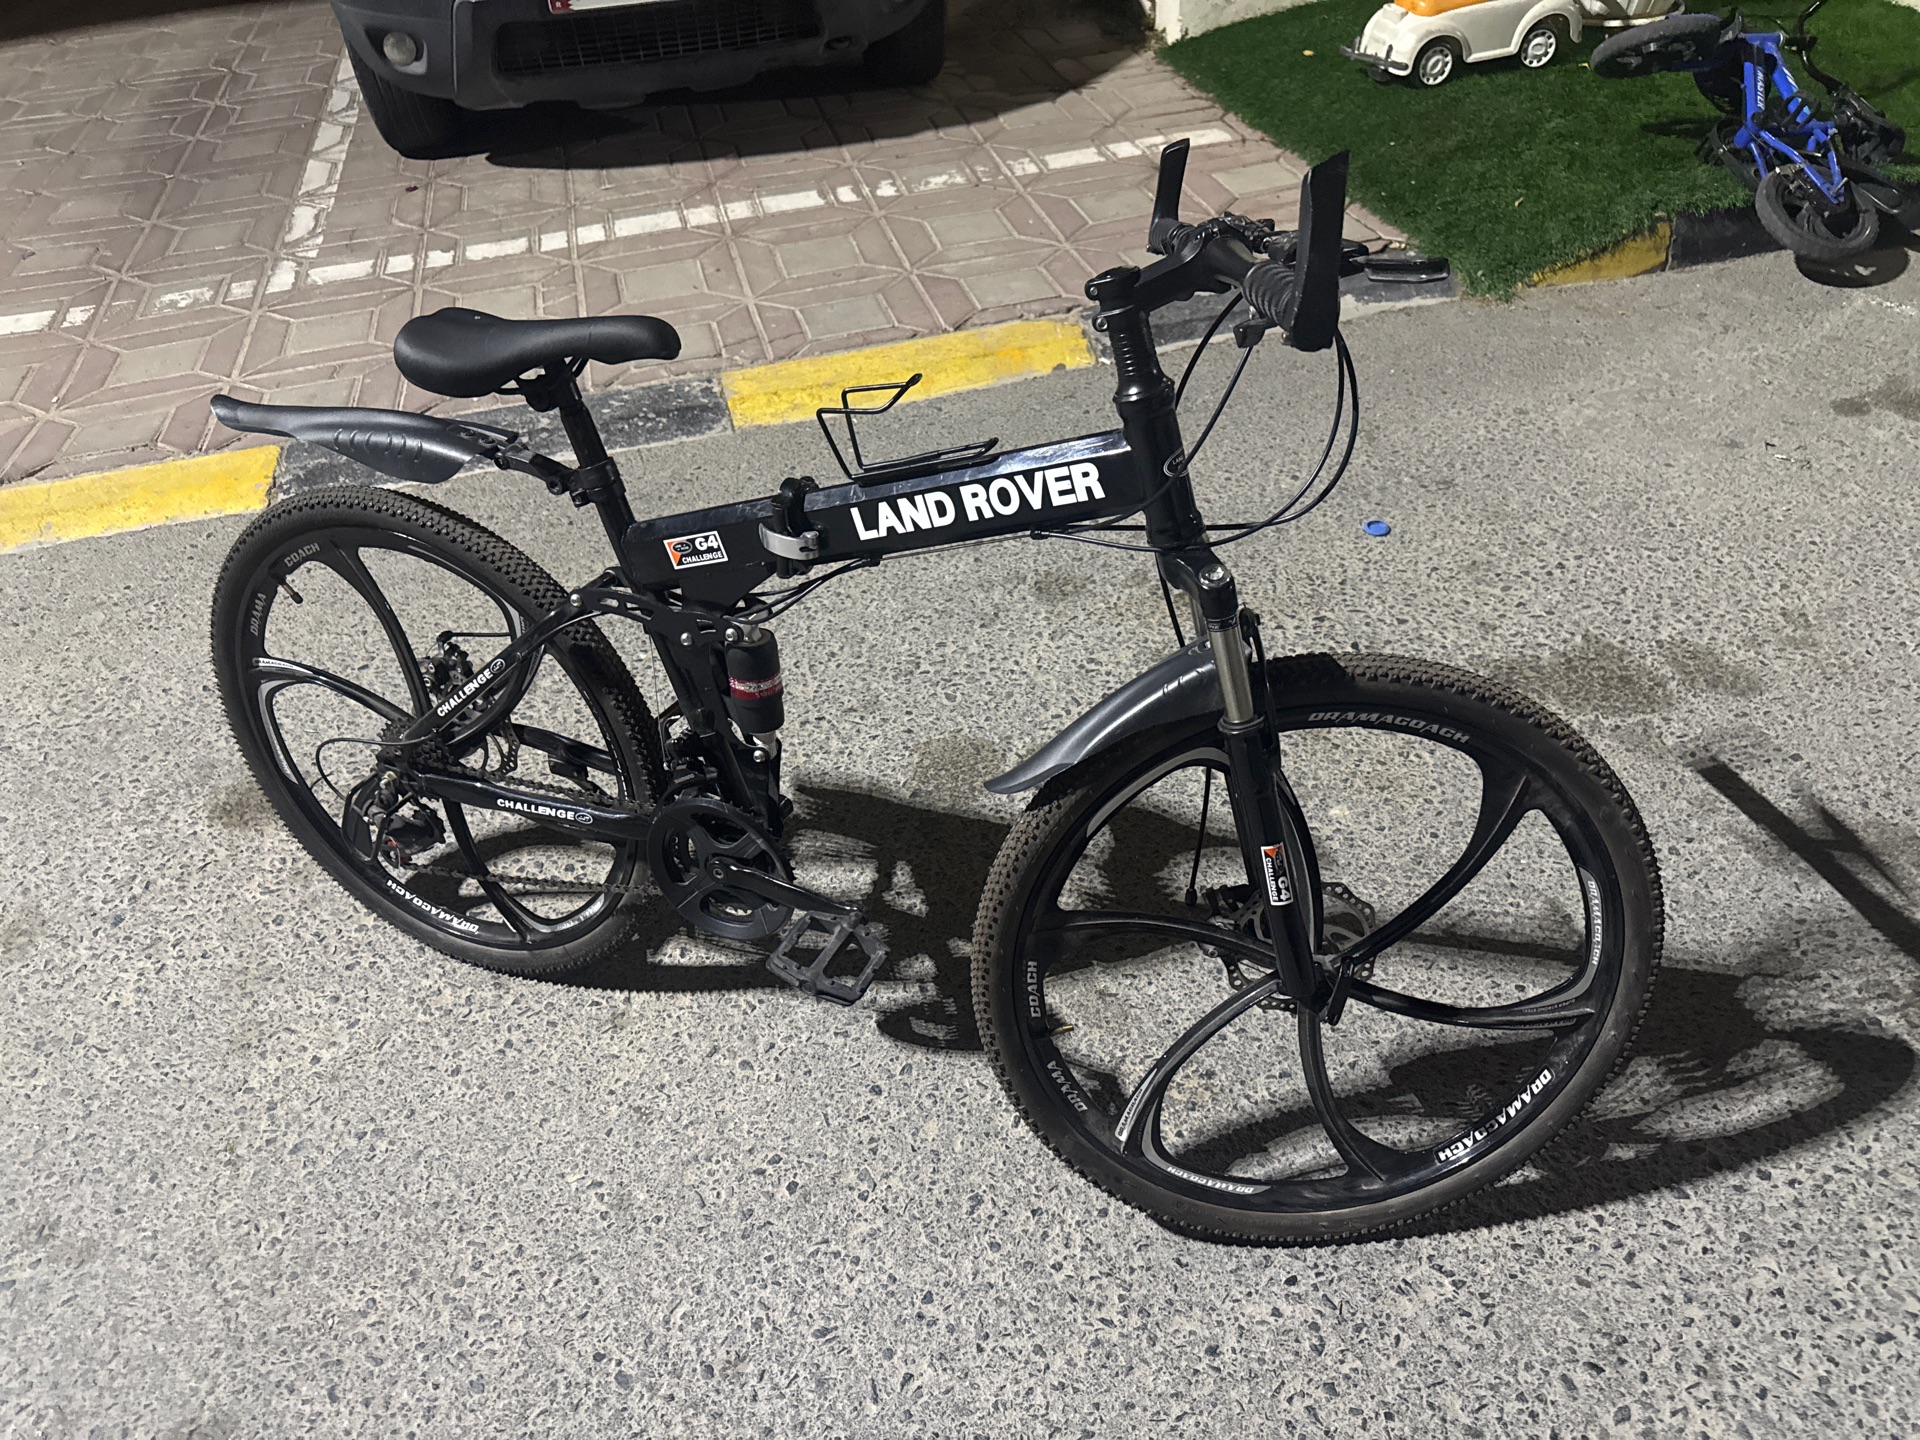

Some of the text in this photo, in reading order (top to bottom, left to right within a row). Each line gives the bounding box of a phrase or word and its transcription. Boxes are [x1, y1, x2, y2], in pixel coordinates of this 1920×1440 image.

[850, 462, 1106, 541] LAND ROVER
[681, 550, 723, 564] CHALLENGE
[694, 535, 719, 551] G4
[250, 542, 320, 636] DRAMA COACH
[437, 668, 494, 717] CHALLENGE
[496, 798, 575, 821] CHALLENGE
[1265, 857, 1279, 901] CHALLENGE
[1277, 876, 1290, 901] G4
[386, 879, 479, 934] DRAMACOACH
[1027, 961, 1088, 1112] DRAMA COACH
[1437, 1069, 1552, 1161] DRAMACOACH
[1167, 1166, 1255, 1194] DRAMACOACH
